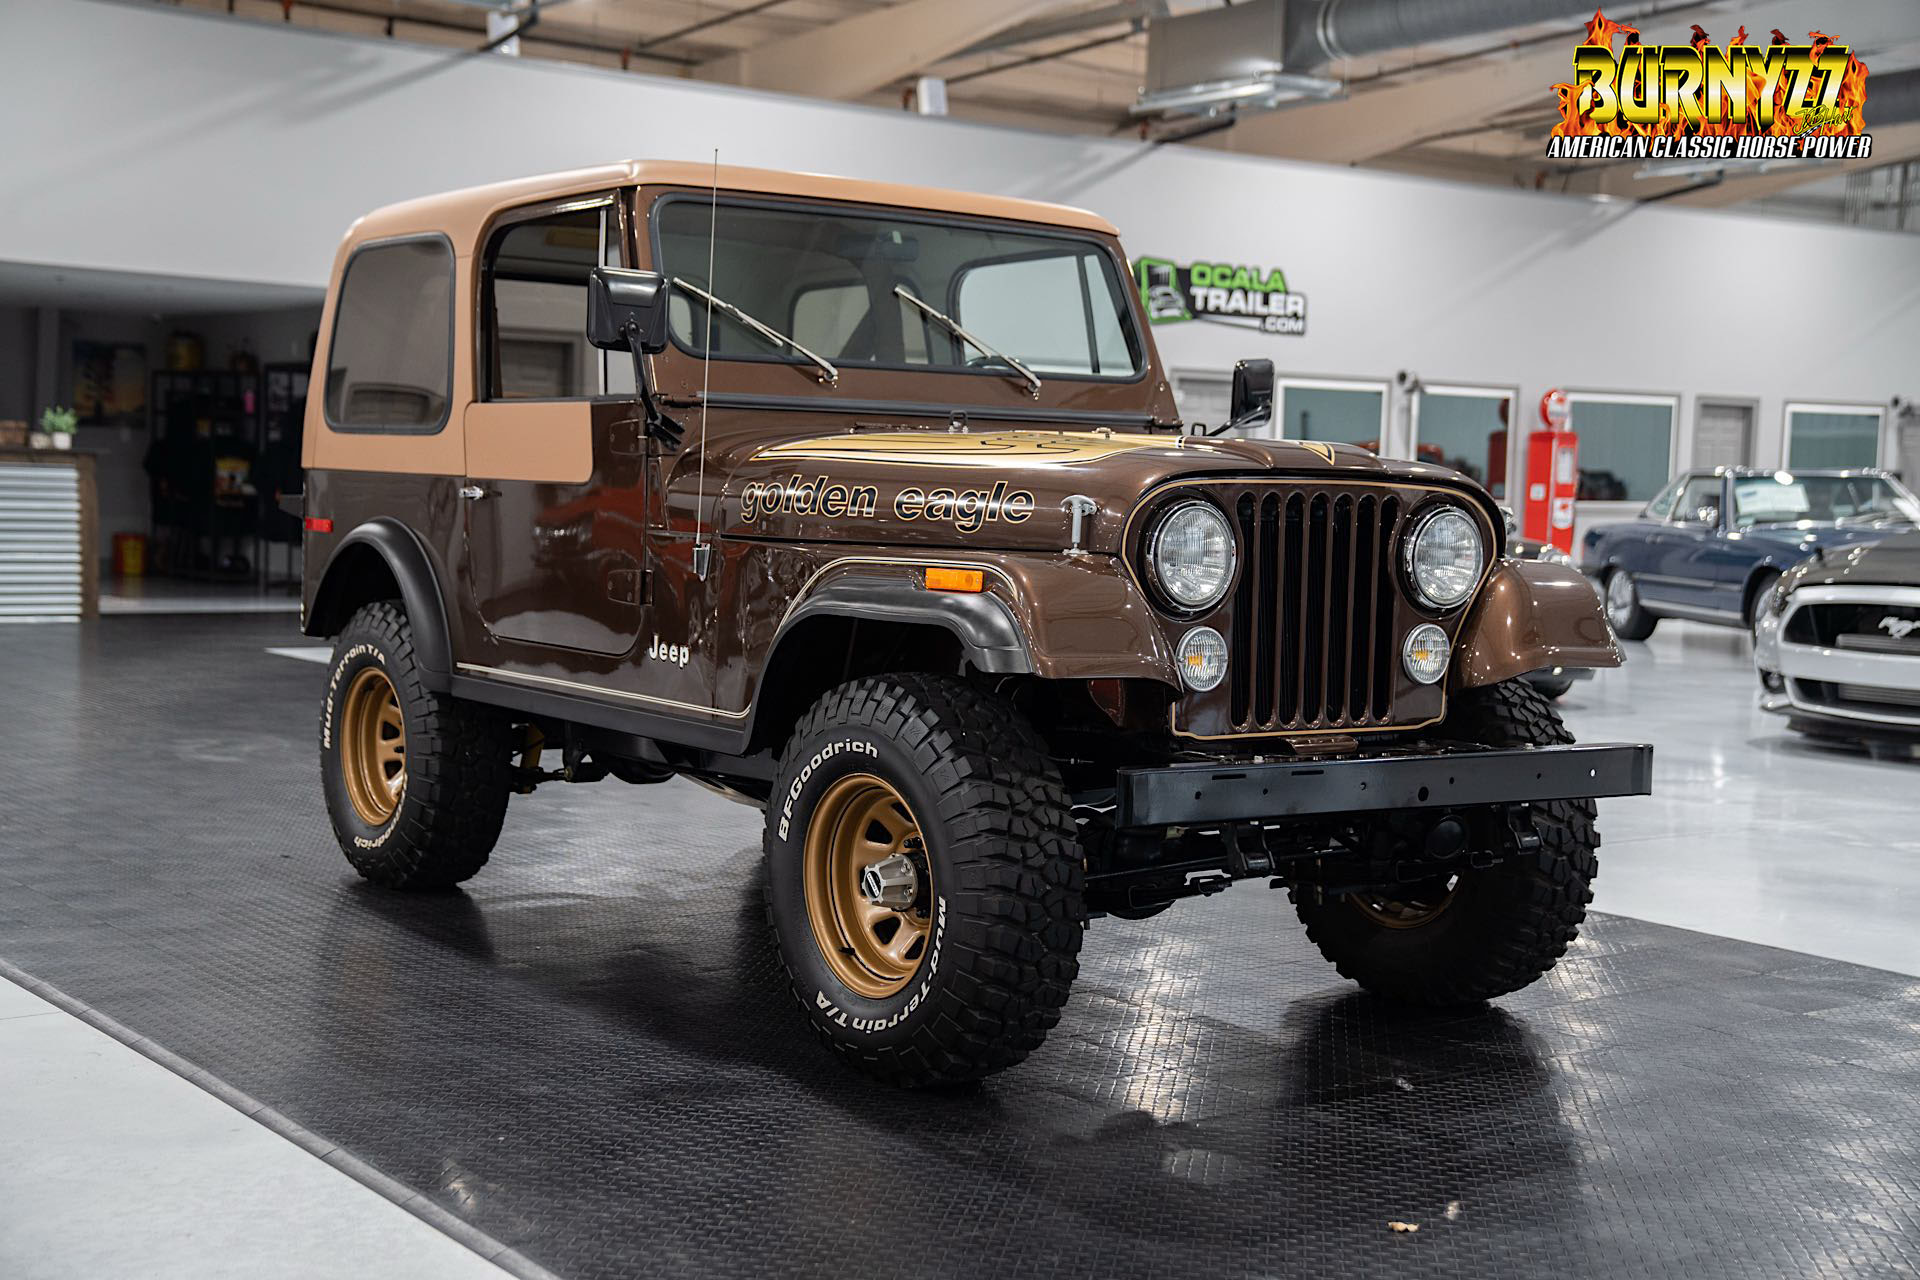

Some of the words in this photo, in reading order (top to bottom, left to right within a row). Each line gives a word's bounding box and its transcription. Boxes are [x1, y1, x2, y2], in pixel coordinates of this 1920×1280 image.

[1190, 263, 1286, 292] OCALA
[1190, 286, 1305, 316] TRAILER
[740, 474, 878, 524] golden
[894, 480, 1035, 534] eagle
[648, 635, 690, 669] Jeep
[778, 738, 879, 842] BFGoodrich
[851, 895, 947, 1034] Mud-Terrain
[815, 990, 848, 1028] T/A
